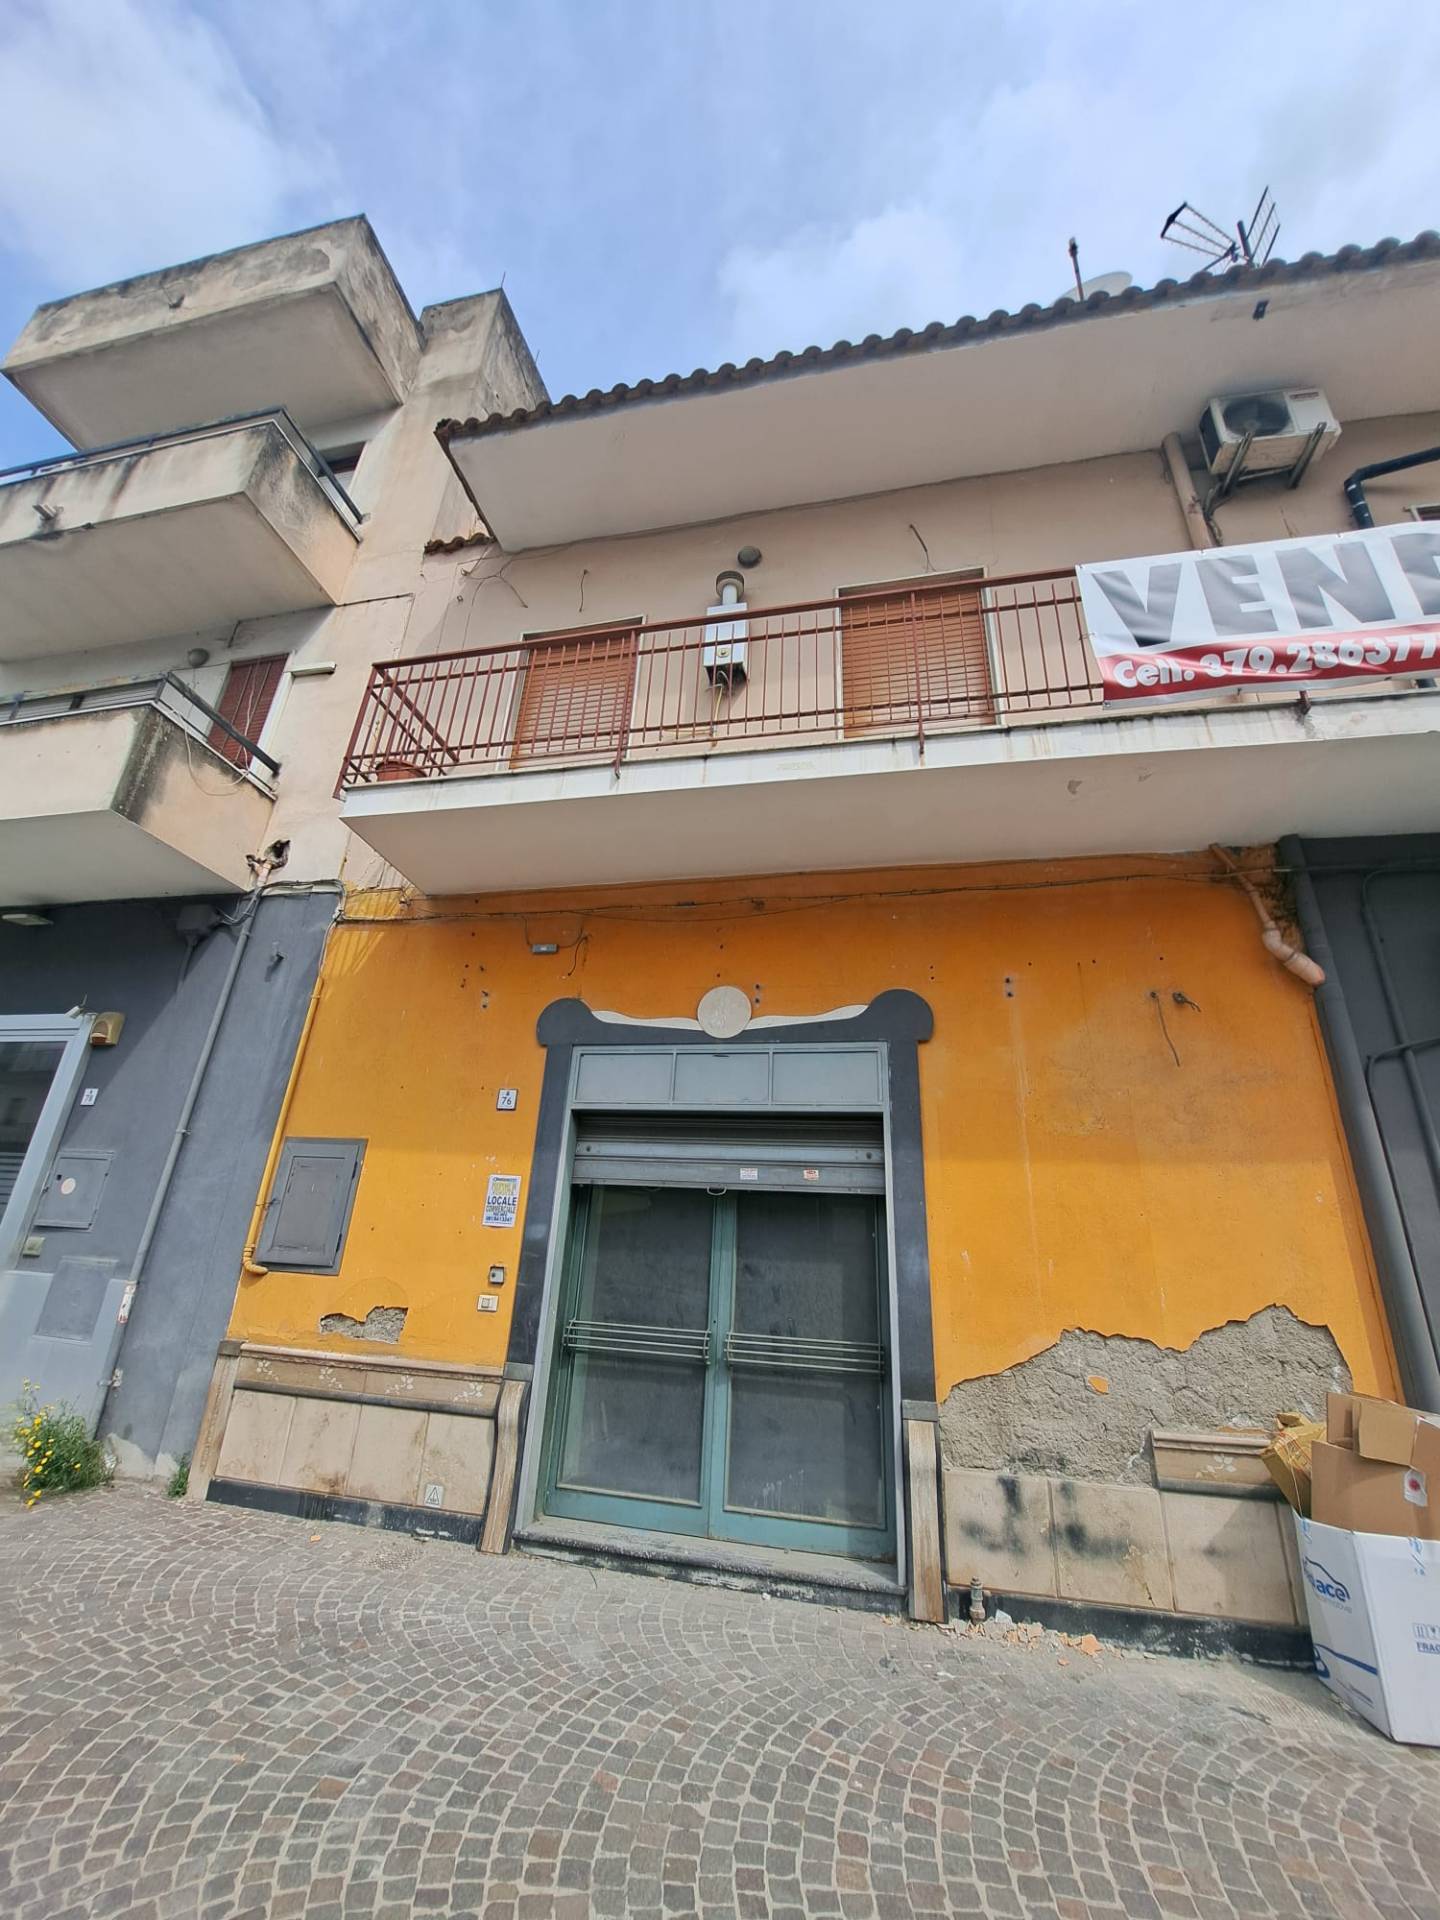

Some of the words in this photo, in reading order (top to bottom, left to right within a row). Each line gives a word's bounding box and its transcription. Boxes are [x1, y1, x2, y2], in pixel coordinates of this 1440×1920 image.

[1113, 659, 1196, 688] Cell.
[500, 1096, 512, 1106] 76
[487, 1195, 517, 1206] LOCALE
